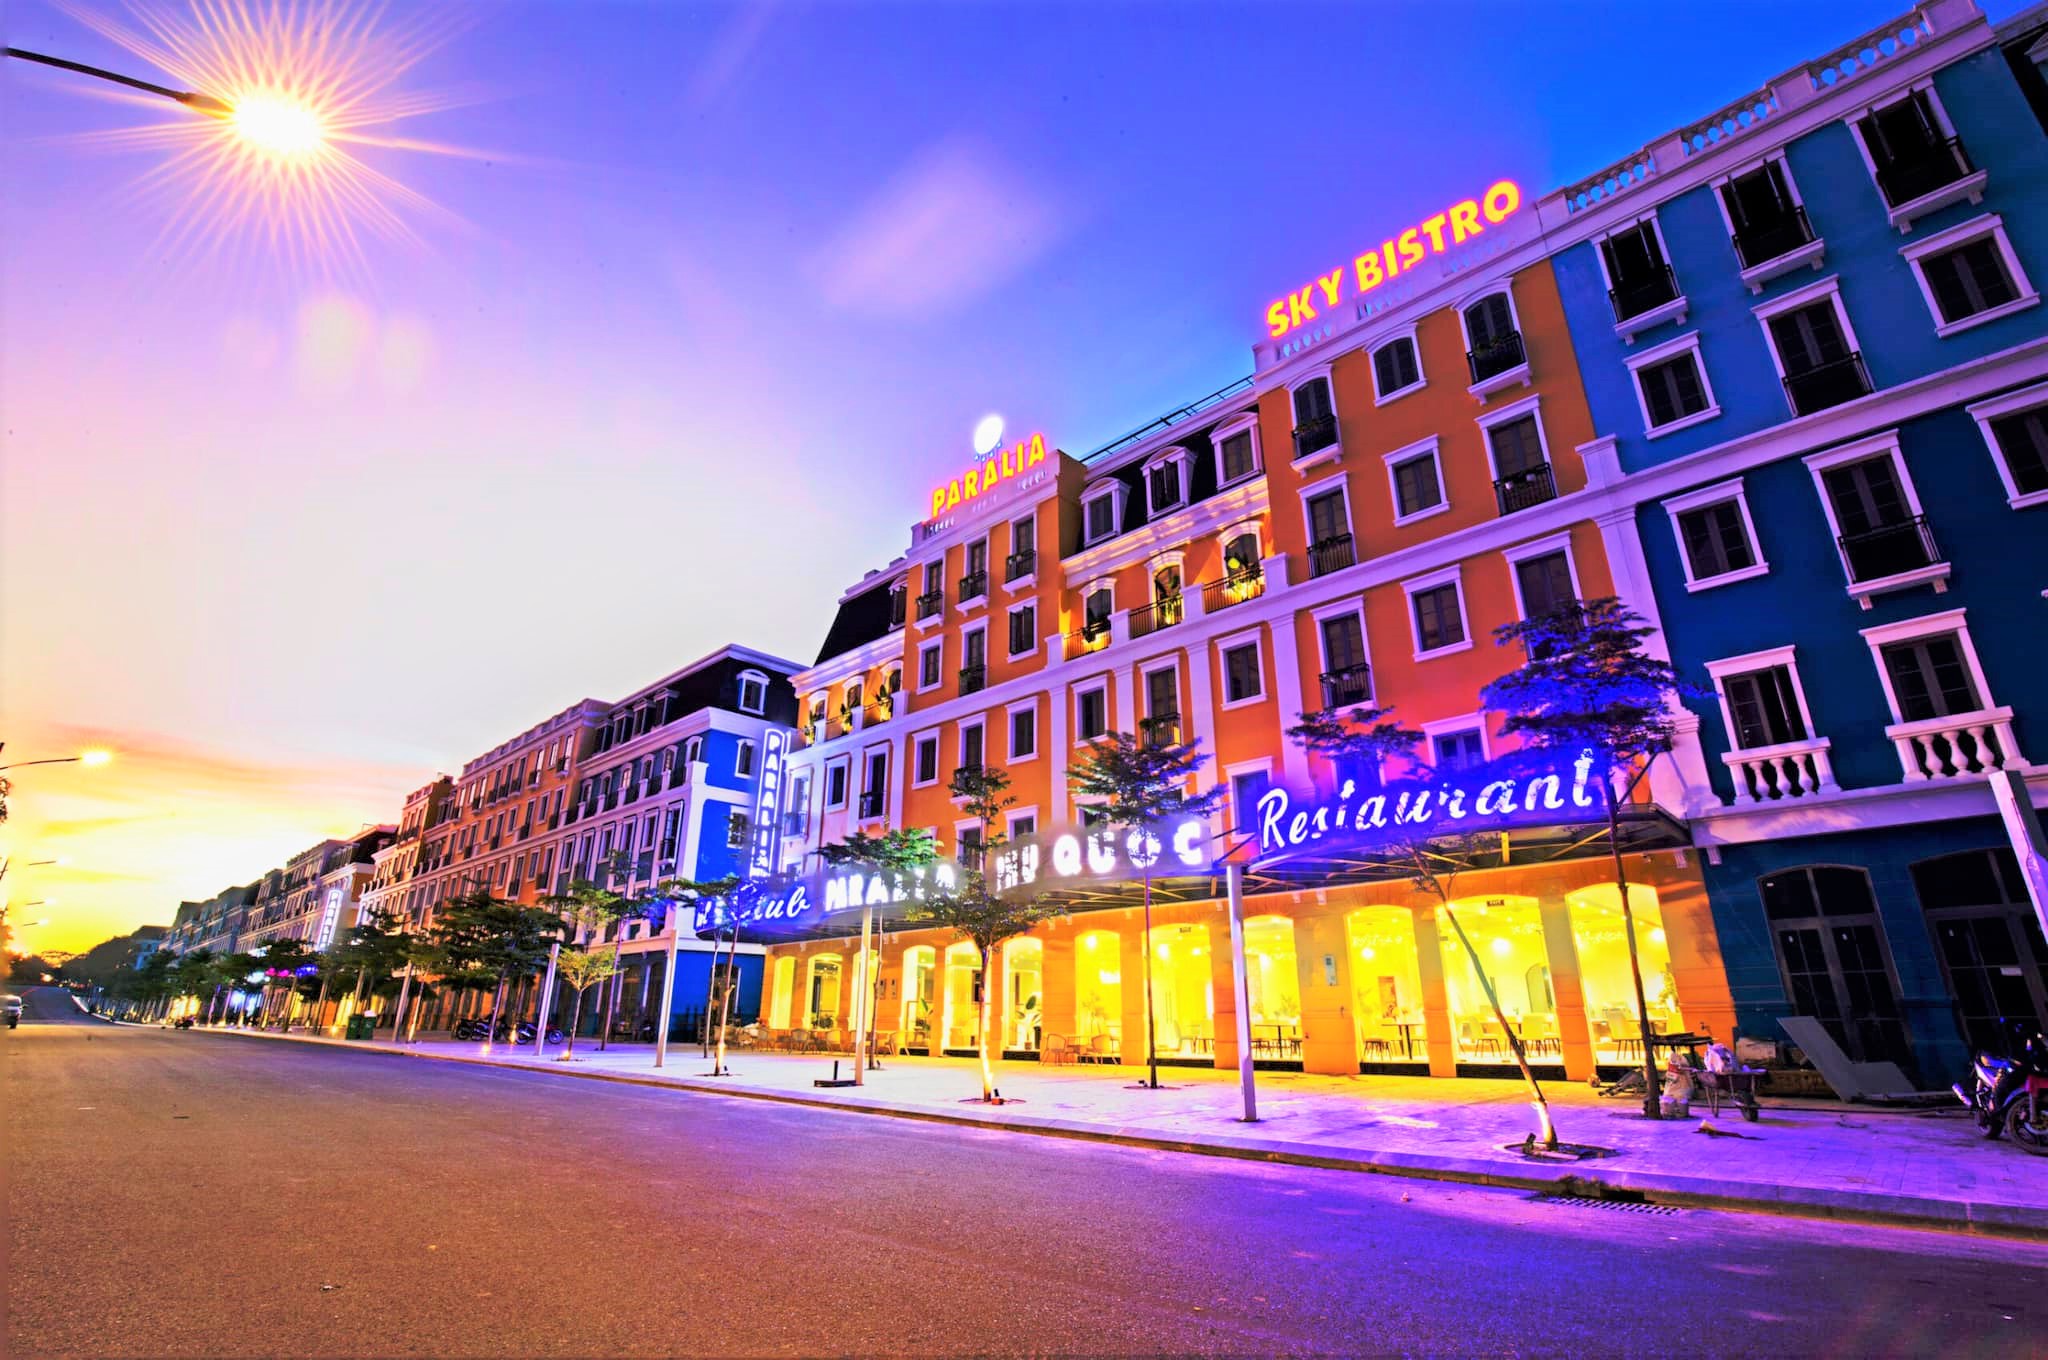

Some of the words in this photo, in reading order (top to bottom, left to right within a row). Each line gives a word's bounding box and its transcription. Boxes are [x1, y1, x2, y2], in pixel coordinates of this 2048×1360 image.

[1266, 269, 1343, 338] SKY
[1355, 180, 1520, 292] BISTRO
[931, 433, 1046, 519] PARALIA
[757, 734, 781, 868] PARALIA
[1052, 820, 1204, 877] QUOC
